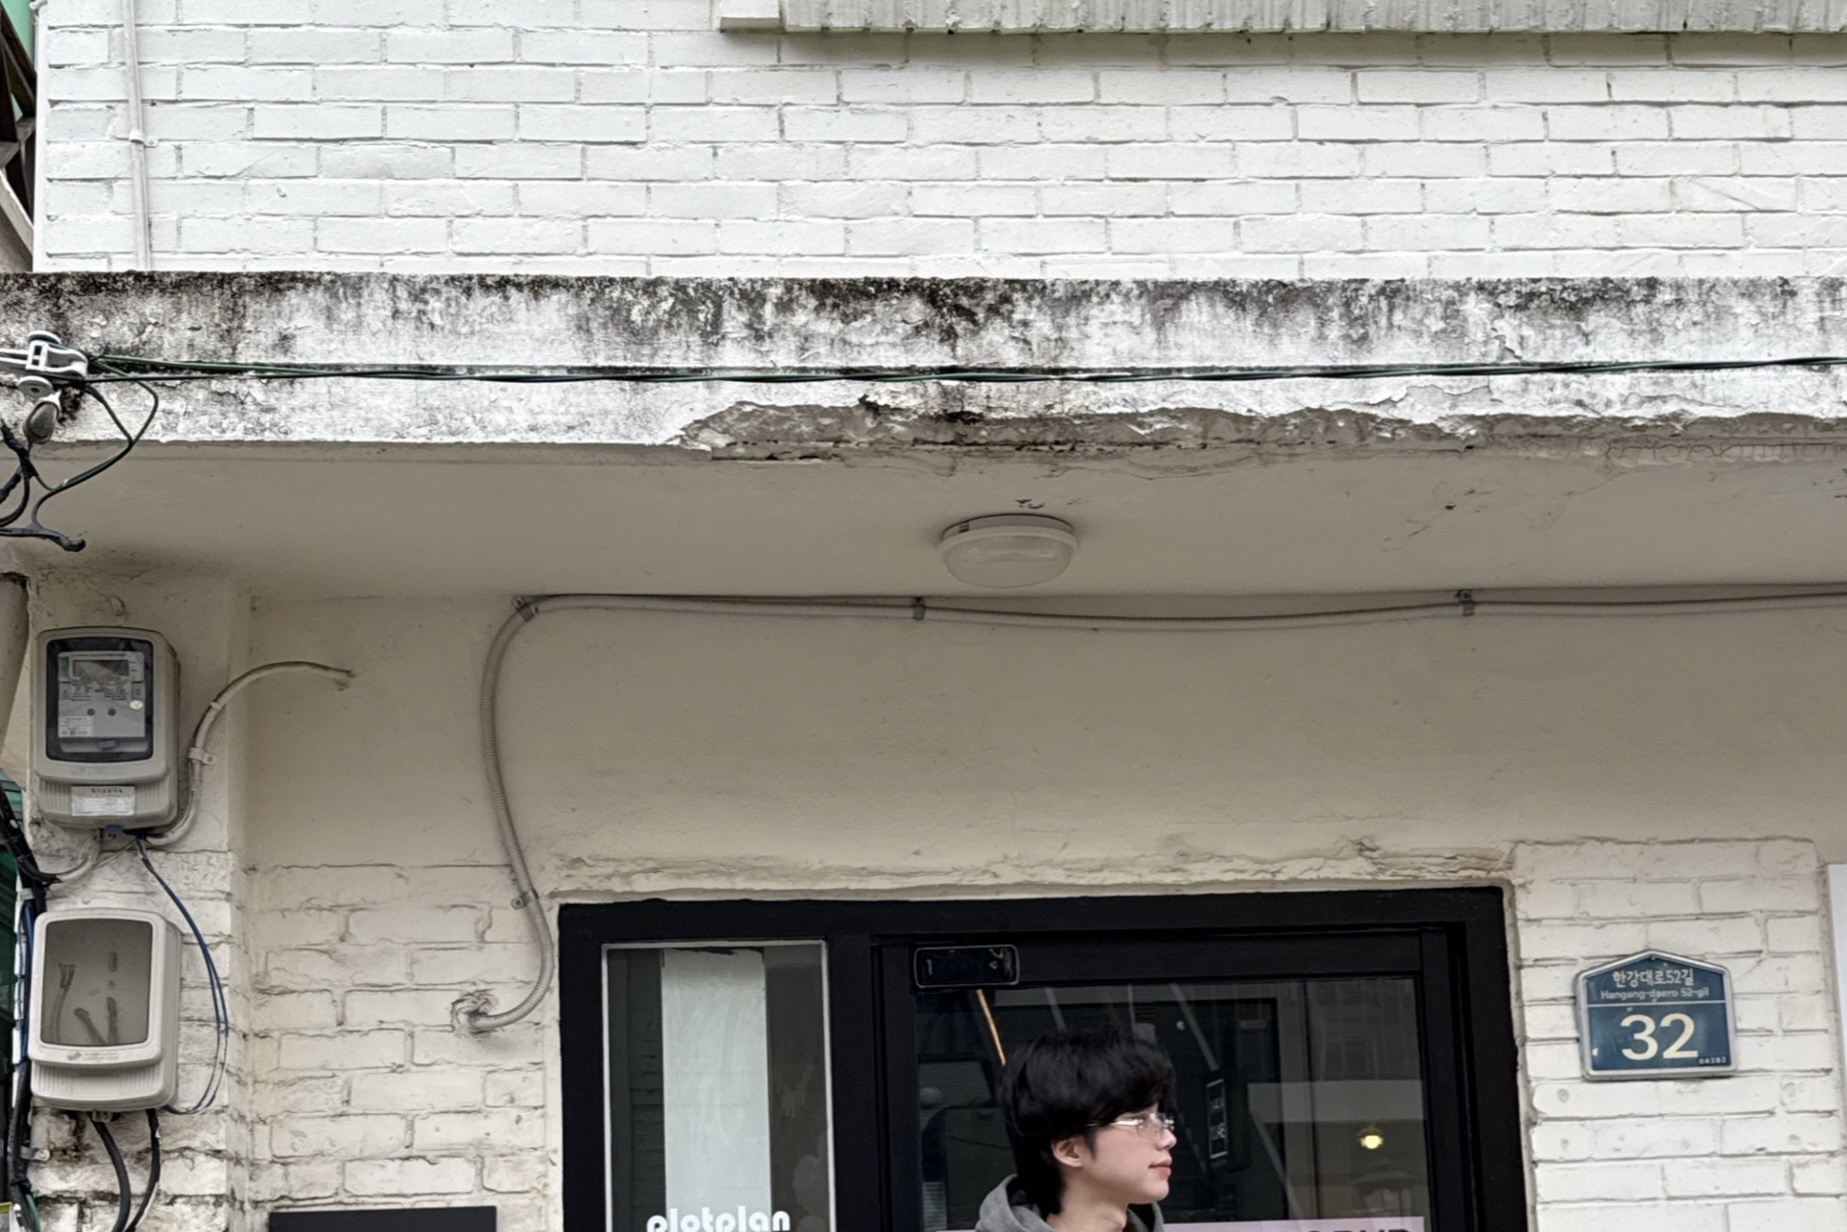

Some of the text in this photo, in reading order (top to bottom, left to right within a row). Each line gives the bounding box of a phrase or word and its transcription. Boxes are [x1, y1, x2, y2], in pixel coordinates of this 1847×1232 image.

[1612, 968, 1694, 988] 한강대로52길
[1680, 987, 1710, 998] 52-gil
[1620, 1013, 1699, 1060] 32
